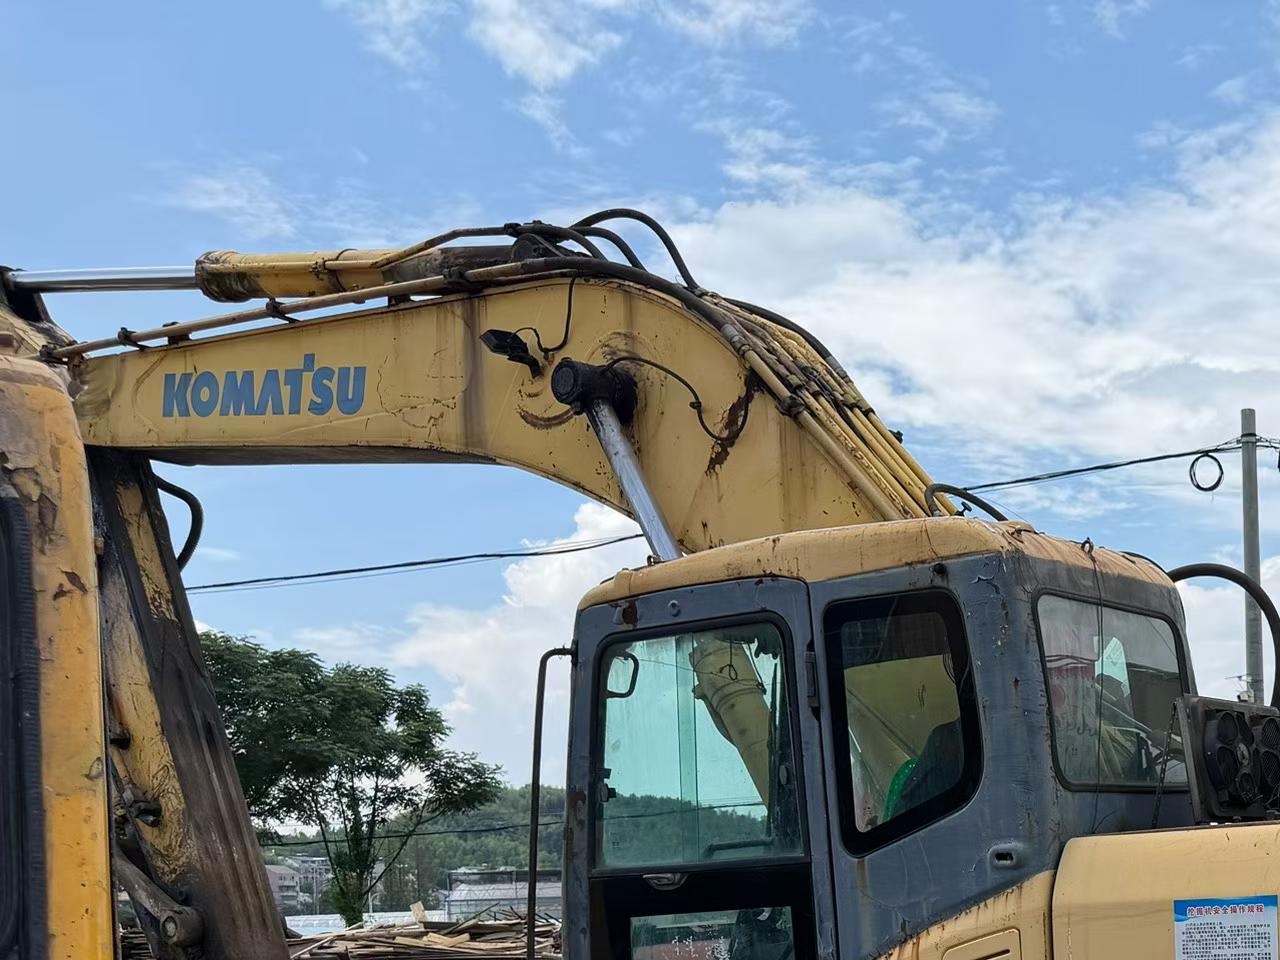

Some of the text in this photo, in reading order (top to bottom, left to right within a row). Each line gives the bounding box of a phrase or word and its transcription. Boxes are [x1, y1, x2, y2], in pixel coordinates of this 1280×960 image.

[162, 353, 367, 417] KOMATSU
[1187, 904, 1265, 917] 挖掘机安全操作规程
